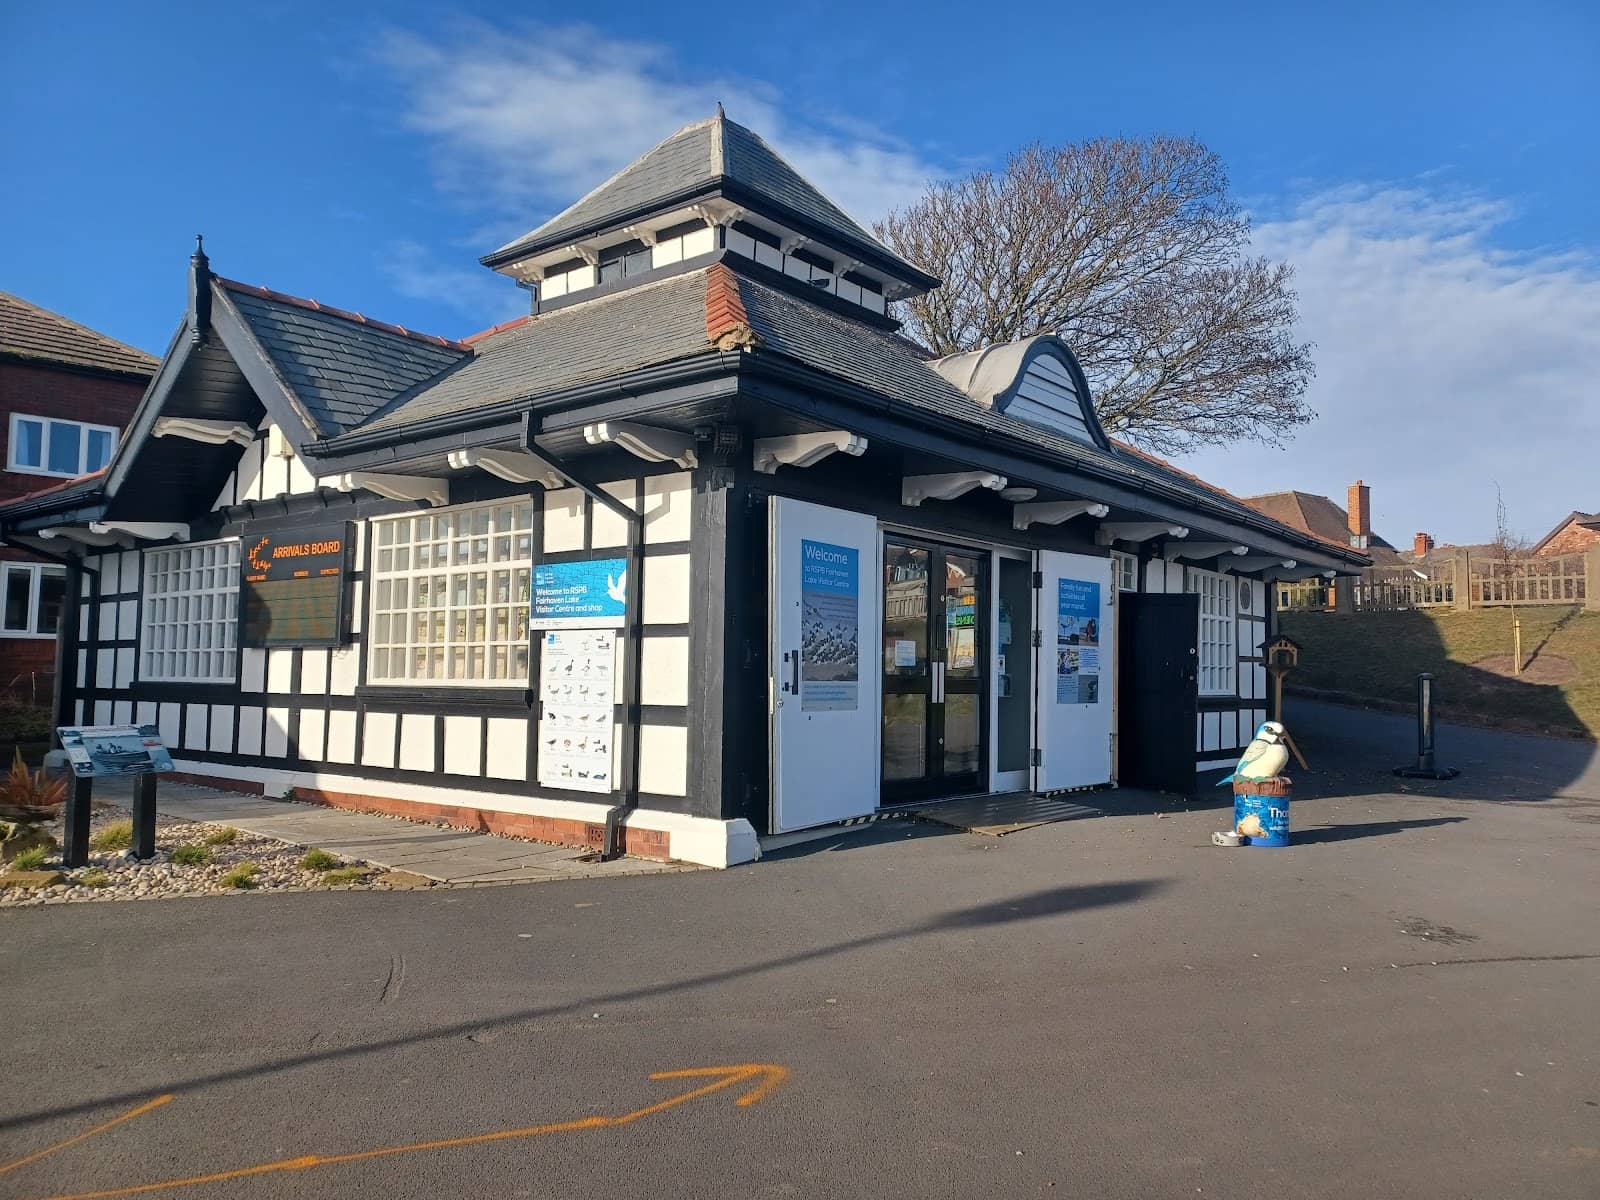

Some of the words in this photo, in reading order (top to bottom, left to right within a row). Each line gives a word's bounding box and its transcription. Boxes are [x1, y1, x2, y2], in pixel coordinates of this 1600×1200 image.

[272, 543, 310, 559] ARRIVALS
[311, 540, 340, 554] BOARD
[804, 544, 848, 565] Welcome
[536, 588, 562, 596] Welcome
[570, 585, 587, 594] RSPB
[536, 596, 564, 605] Fairhaven
[565, 595, 580, 603] Lake
[536, 605, 554, 614] Visitor
[554, 604, 574, 613] Centre
[587, 603, 603, 613] shop
